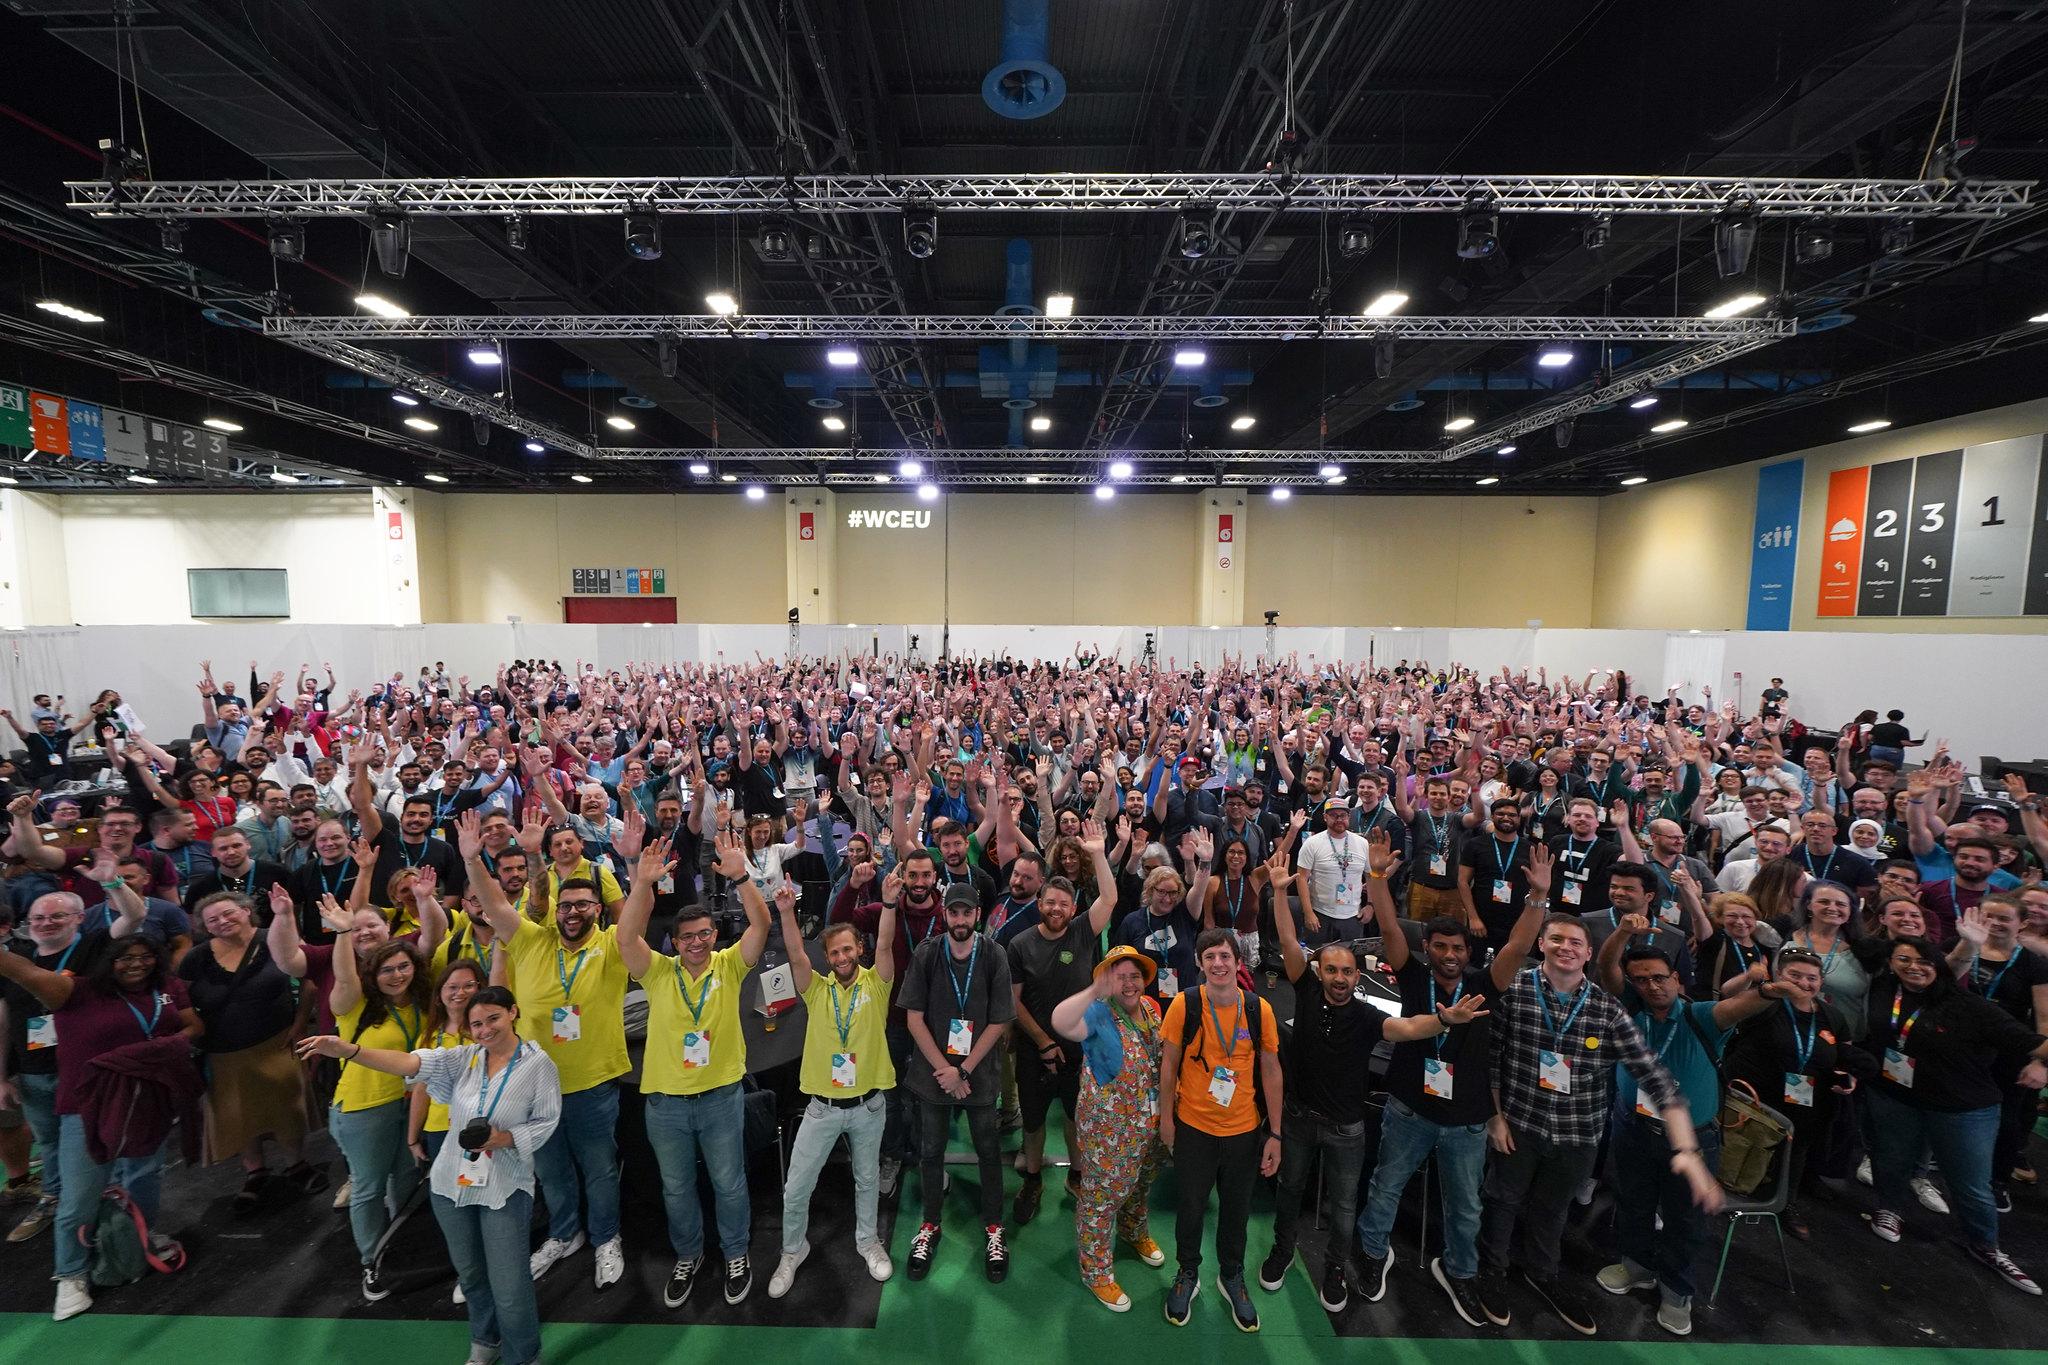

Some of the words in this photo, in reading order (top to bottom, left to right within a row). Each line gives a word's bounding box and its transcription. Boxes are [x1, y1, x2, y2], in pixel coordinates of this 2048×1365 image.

[118, 415, 132, 434] 1
[182, 430, 197, 449] 2
[209, 435, 222, 454] 3
[847, 510, 931, 529] #WCEU
[1919, 502, 1945, 532] 3
[1981, 496, 2005, 527] 1
[1873, 510, 1898, 537] 2
[575, 569, 583, 579] 2
[588, 569, 595, 579] 3
[616, 569, 622, 579] 1
